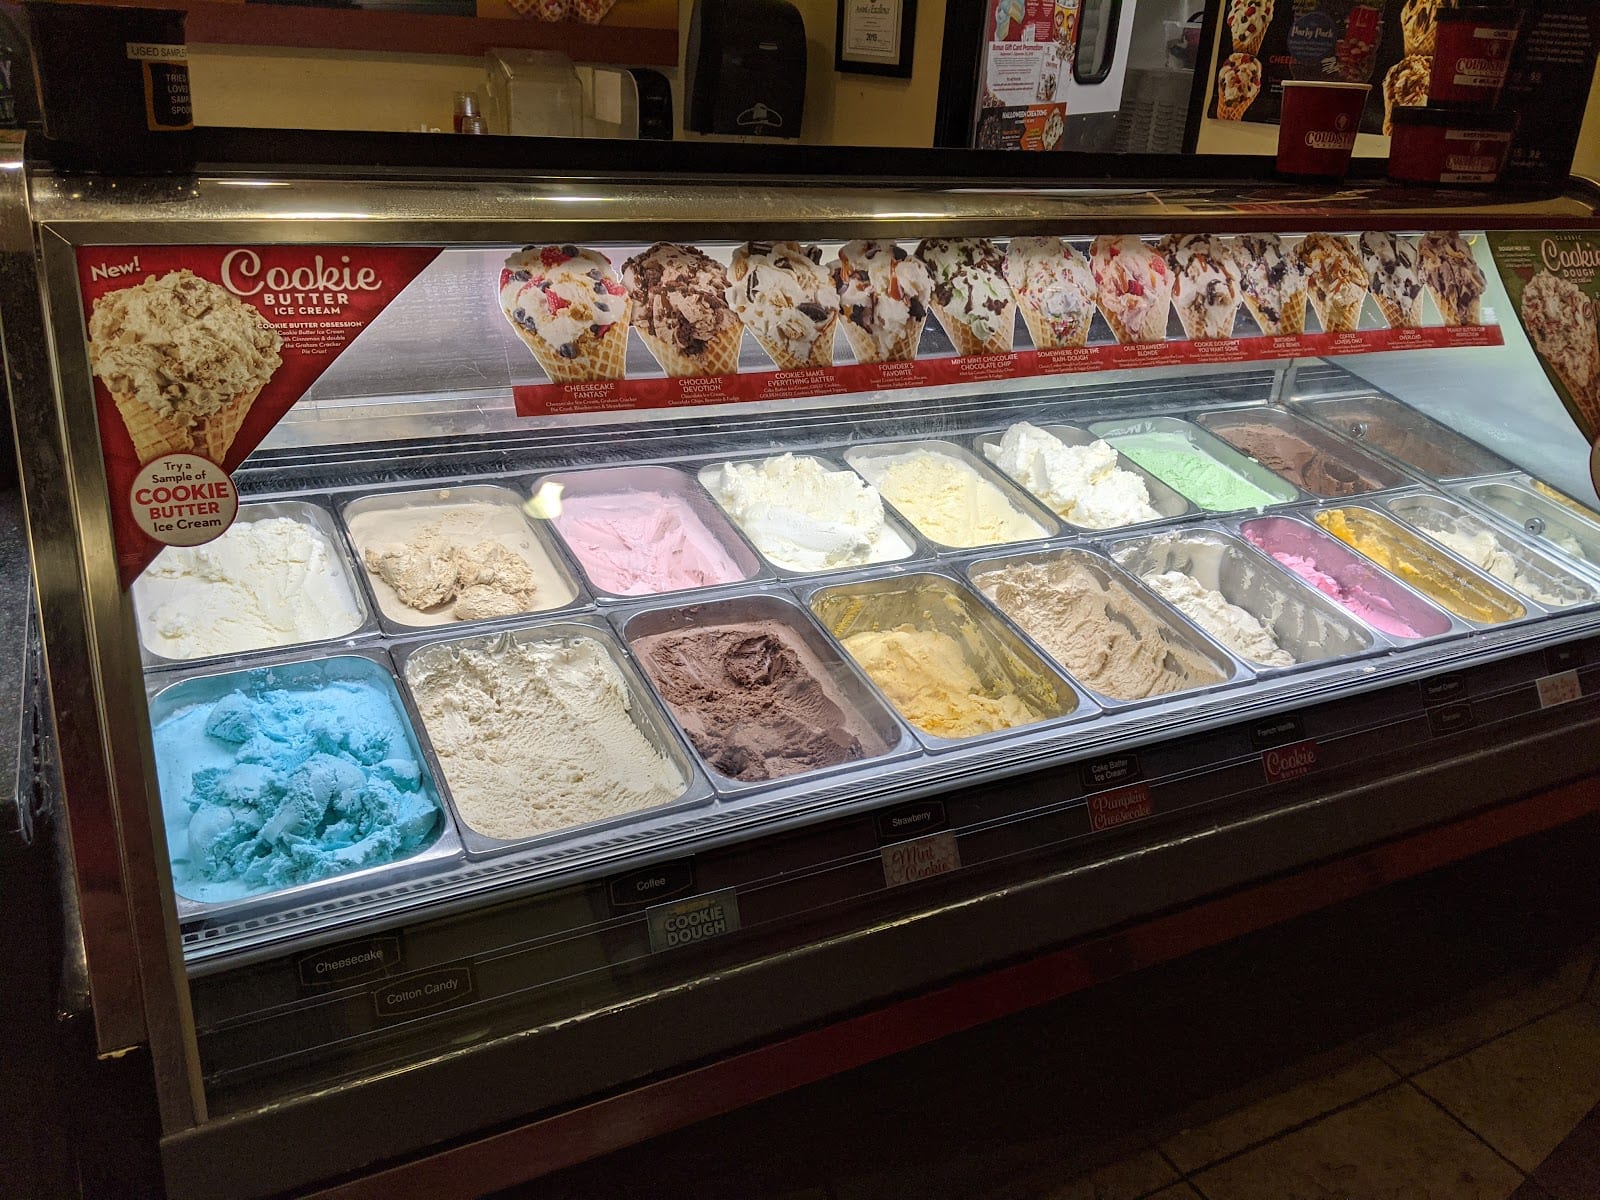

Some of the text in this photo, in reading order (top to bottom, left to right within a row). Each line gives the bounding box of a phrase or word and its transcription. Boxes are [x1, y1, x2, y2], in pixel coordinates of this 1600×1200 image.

[90, 255, 142, 282] New!
[221, 249, 383, 297] Cookie
[1562, 268, 1595, 278] DOUGH
[264, 293, 349, 306] BUTTER
[275, 306, 341, 316] ICE CREAM
[257, 322, 288, 330] COOKIE
[982, 354, 1018, 362] CHOCOLATE
[774, 372, 805, 380] COOKIES
[882, 369, 912, 377] FAVORITE
[564, 382, 615, 392] CHEESECAKE
[678, 378, 722, 387] CHOCOLATE
[683, 385, 721, 393] DEVOTION
[767, 378, 810, 388] EVERYTHING
[574, 390, 608, 399] FANTASY
[164, 462, 183, 472] Try
[152, 470, 207, 484] Sample of
[135, 482, 230, 506] COOKIE
[149, 502, 220, 520] BUTTER
[153, 519, 222, 532] Ice Cream
[1092, 760, 1128, 774] Cake Batter
[1267, 747, 1317, 776] Cookie
[1094, 768, 1127, 782] Ice Cream
[1092, 790, 1146, 812] Pumpkin
[892, 812, 931, 827] Strawberry
[1094, 805, 1151, 830] Cheesecake
[892, 846, 935, 864] Mint
[636, 876, 666, 892] Coffee
[665, 904, 724, 932] COOKIE
[667, 920, 726, 946] DOUGH
[315, 949, 384, 974] Cheesecake
[386, 978, 458, 1005] Cotton Candy
